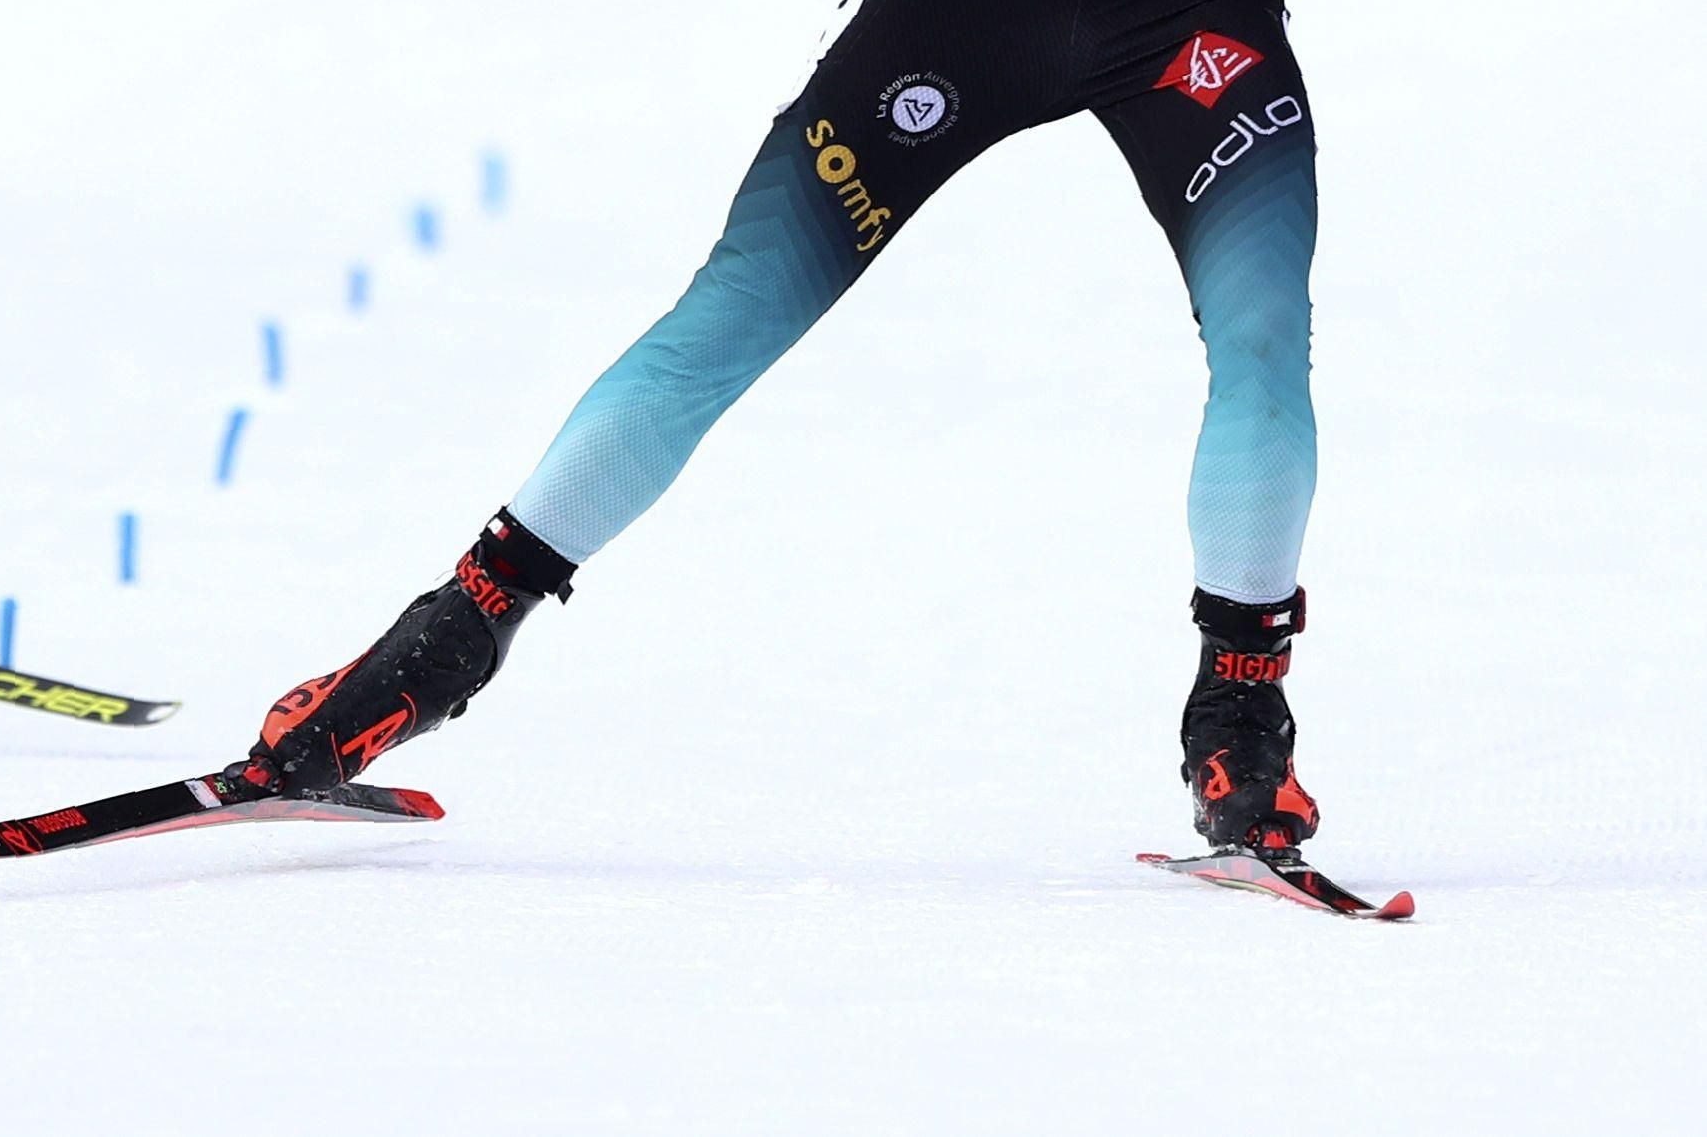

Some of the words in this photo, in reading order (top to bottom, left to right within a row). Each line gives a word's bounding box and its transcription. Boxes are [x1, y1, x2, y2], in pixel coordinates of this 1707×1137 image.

[875, 104, 888, 119] La
[1184, 95, 1303, 203] odlo
[805, 119, 892, 252] somfy
